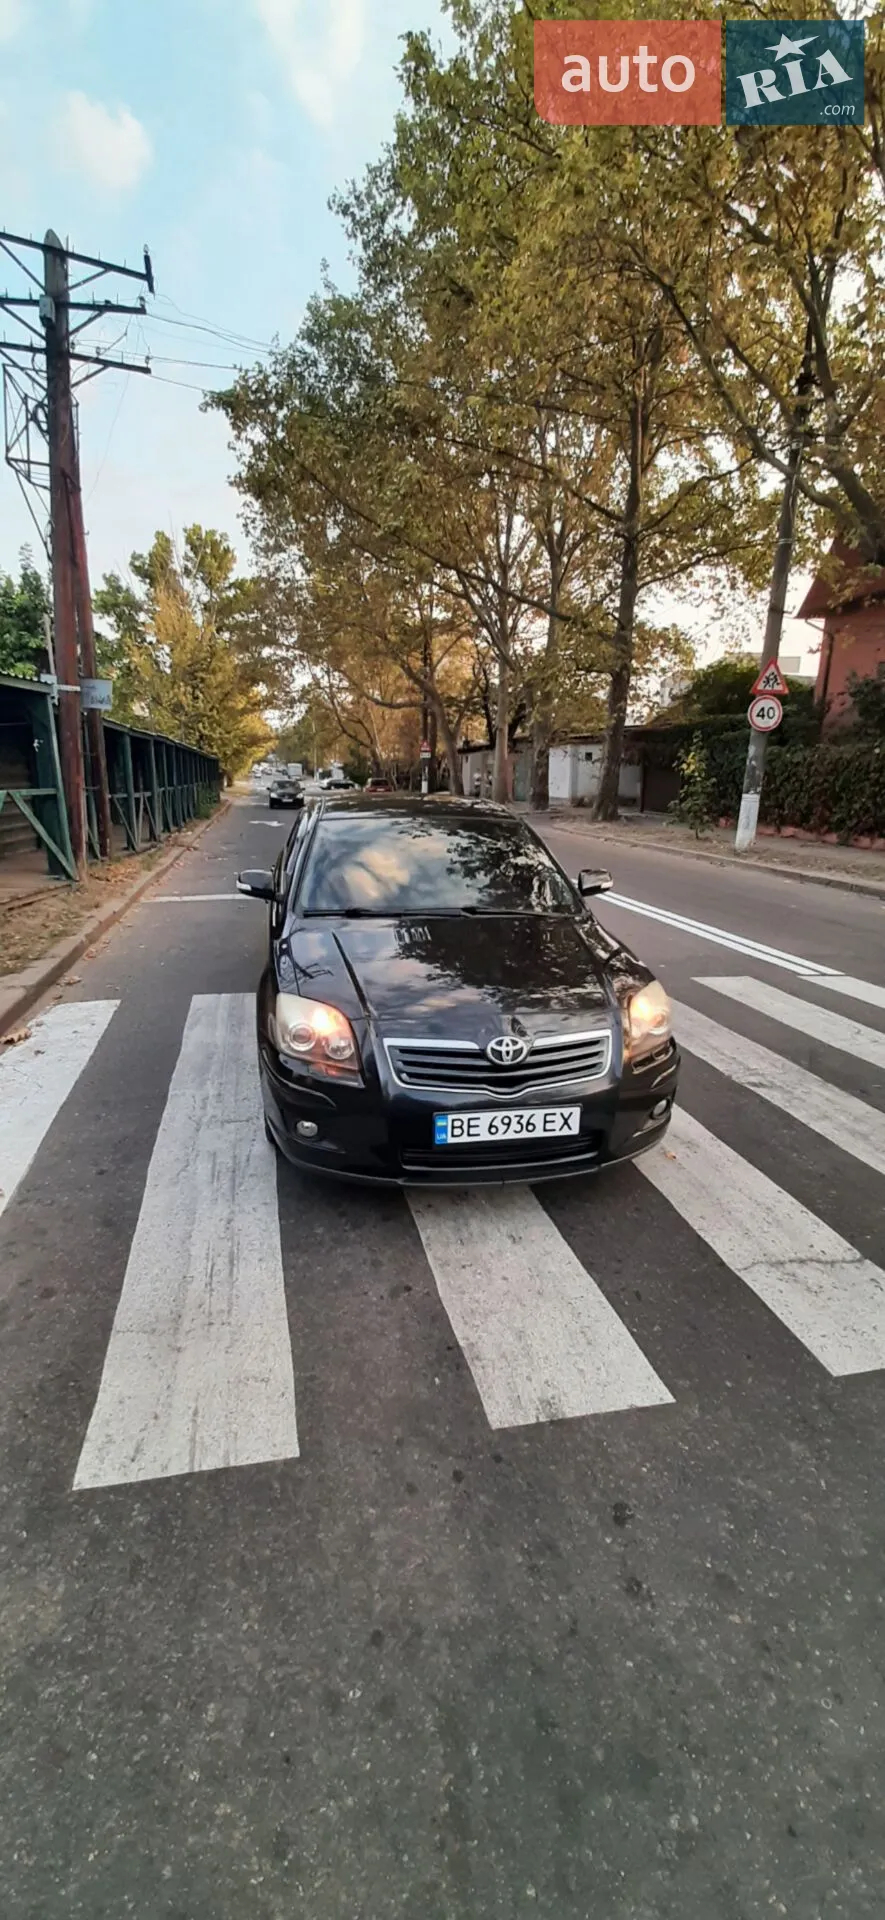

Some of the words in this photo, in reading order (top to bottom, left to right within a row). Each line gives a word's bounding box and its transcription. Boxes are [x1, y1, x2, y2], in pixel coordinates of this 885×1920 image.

[756, 706, 776, 720] 40
[451, 1117, 481, 1138] BE
[488, 1113, 537, 1136] 6936
[543, 1111, 573, 1133] EX
